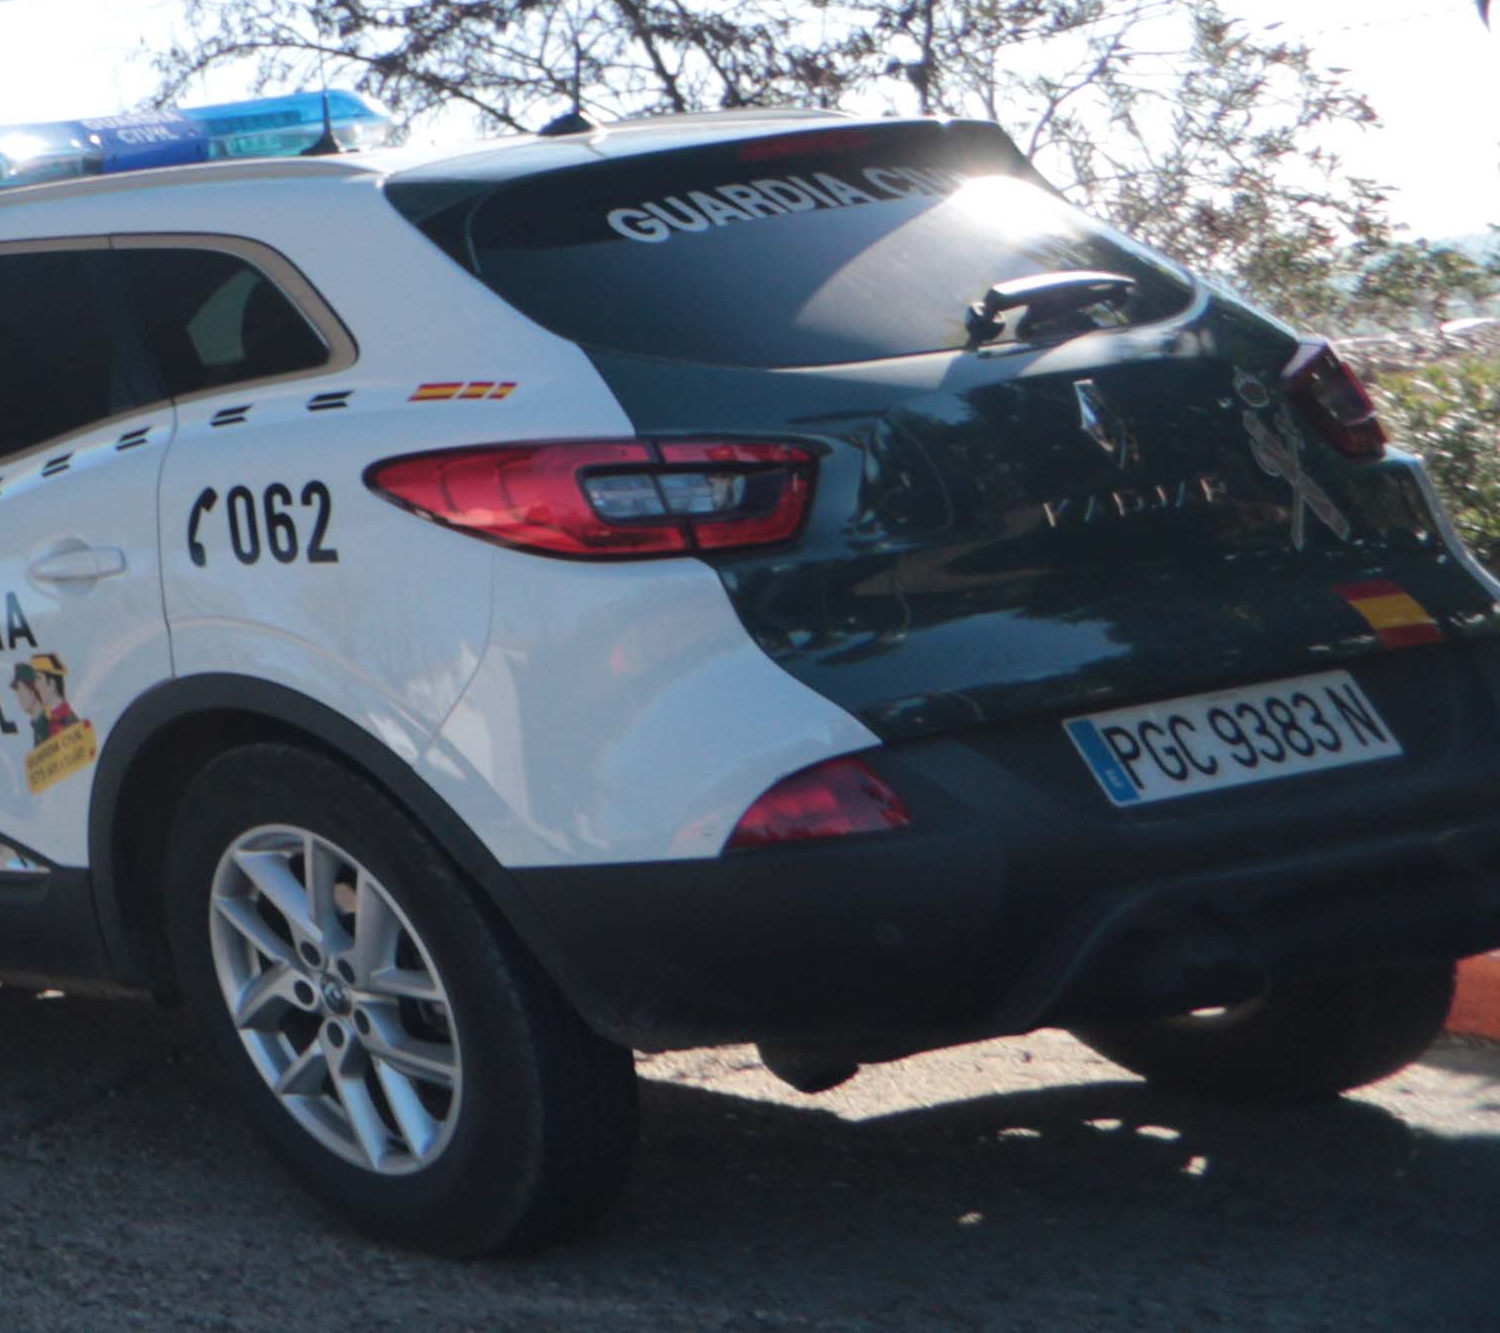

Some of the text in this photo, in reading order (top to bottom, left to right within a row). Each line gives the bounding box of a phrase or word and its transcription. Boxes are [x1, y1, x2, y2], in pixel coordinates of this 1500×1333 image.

[607, 172, 871, 244] GUARDIA
[227, 479, 339, 565] 062
[1102, 683, 1387, 790] PGC 9383 N
